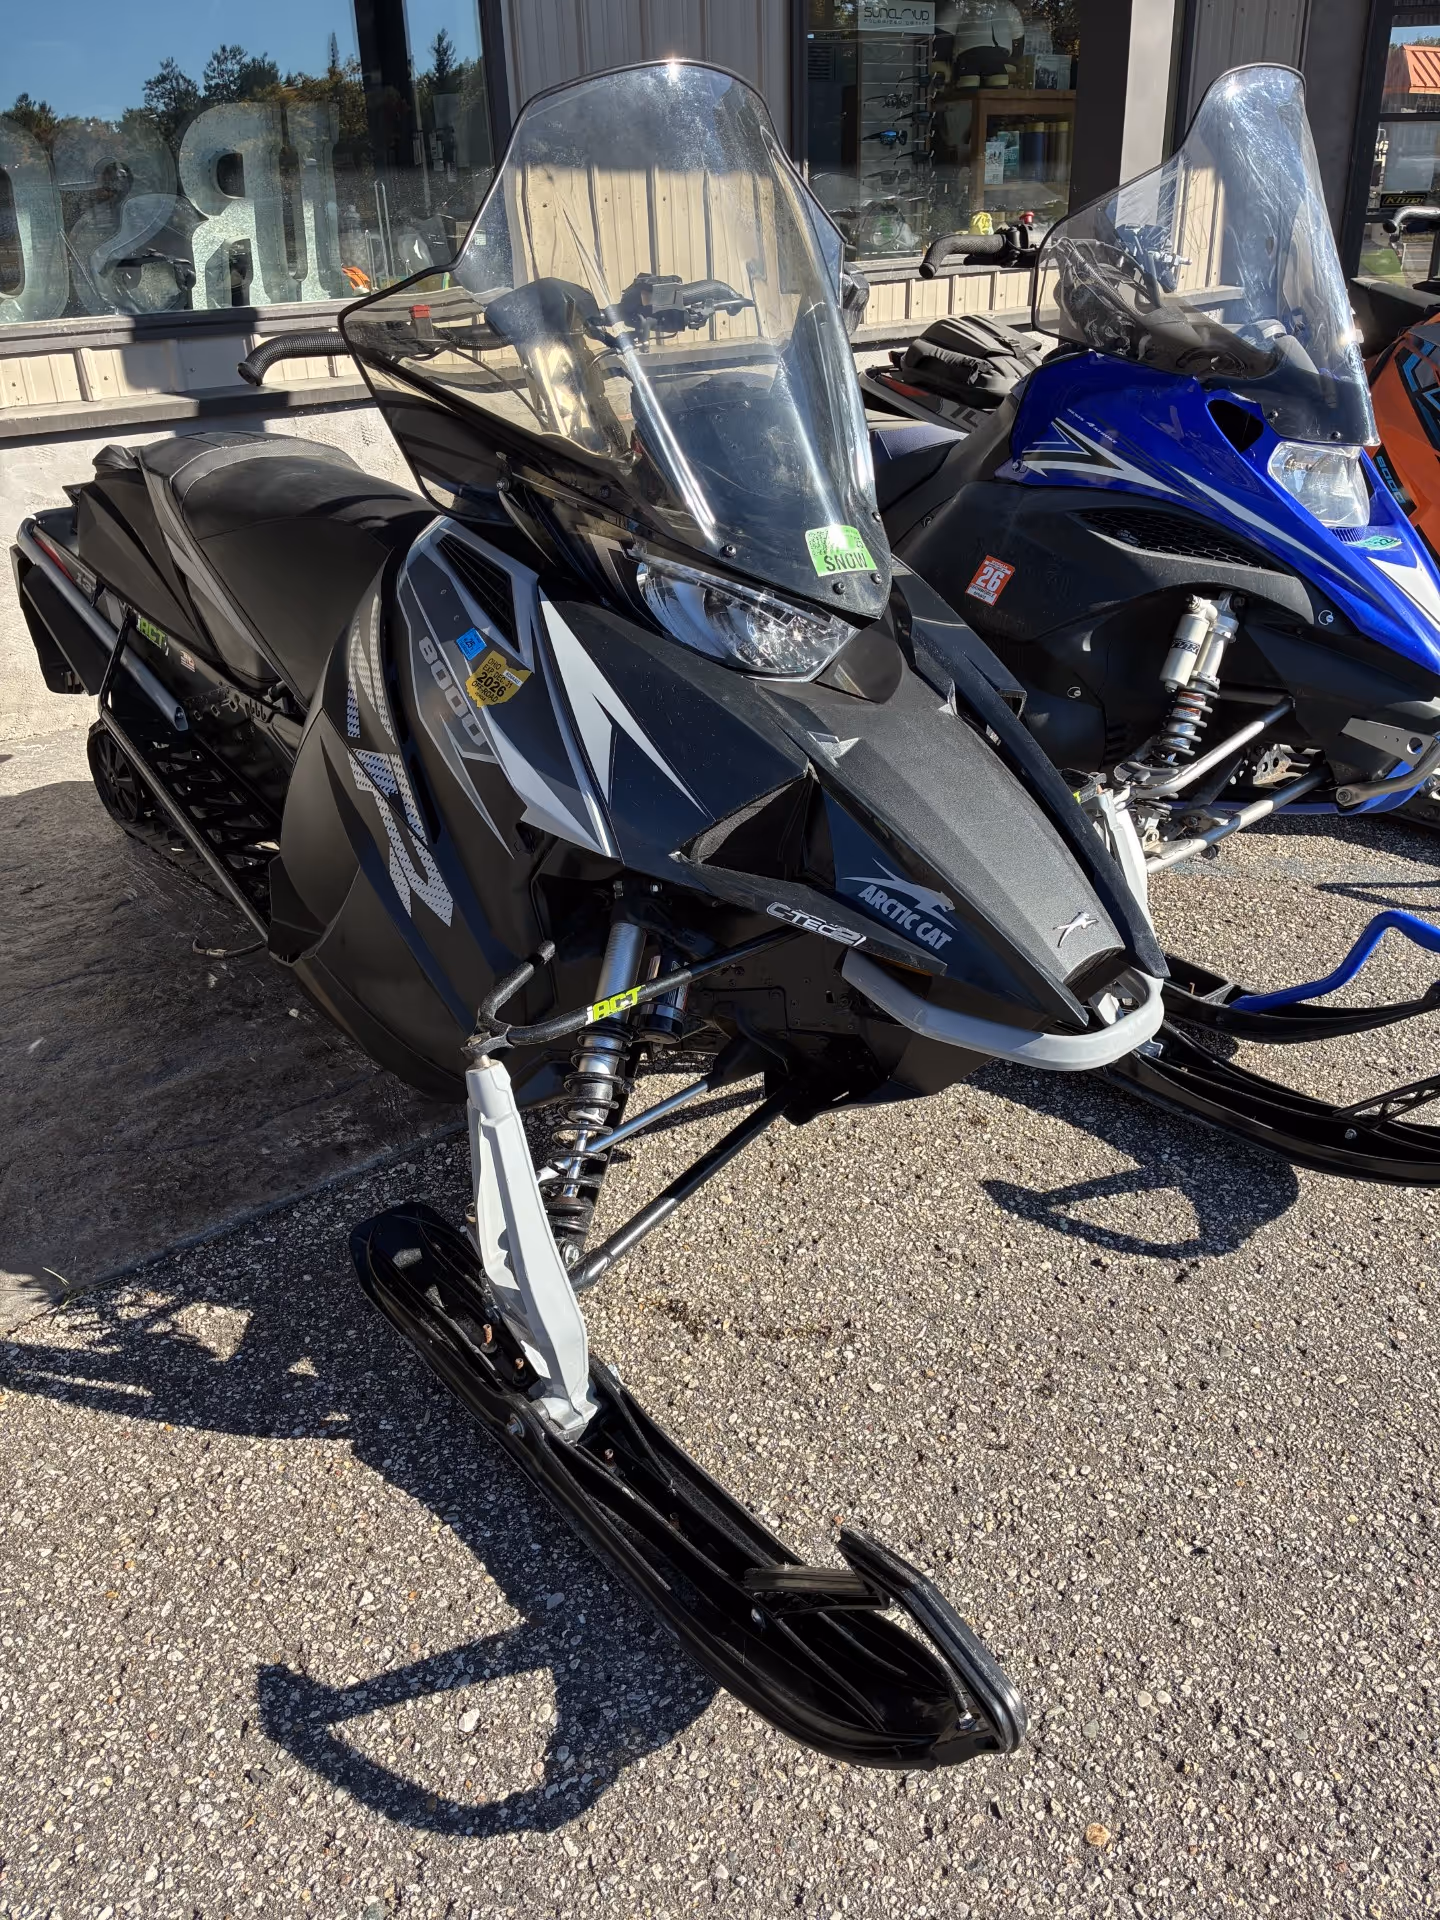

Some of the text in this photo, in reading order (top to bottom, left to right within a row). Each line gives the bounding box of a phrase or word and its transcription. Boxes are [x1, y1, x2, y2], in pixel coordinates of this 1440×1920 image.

[824, 552, 868, 572] SNOW
[976, 566, 1005, 592] 26
[482, 664, 494, 676] EXP.
[487, 658, 502, 670] OHIO
[419, 636, 487, 746] 8000
[471, 680, 499, 702] OFF-ROAD
[476, 671, 507, 697] 2026
[858, 885, 952, 950] ARCTIC CAT
